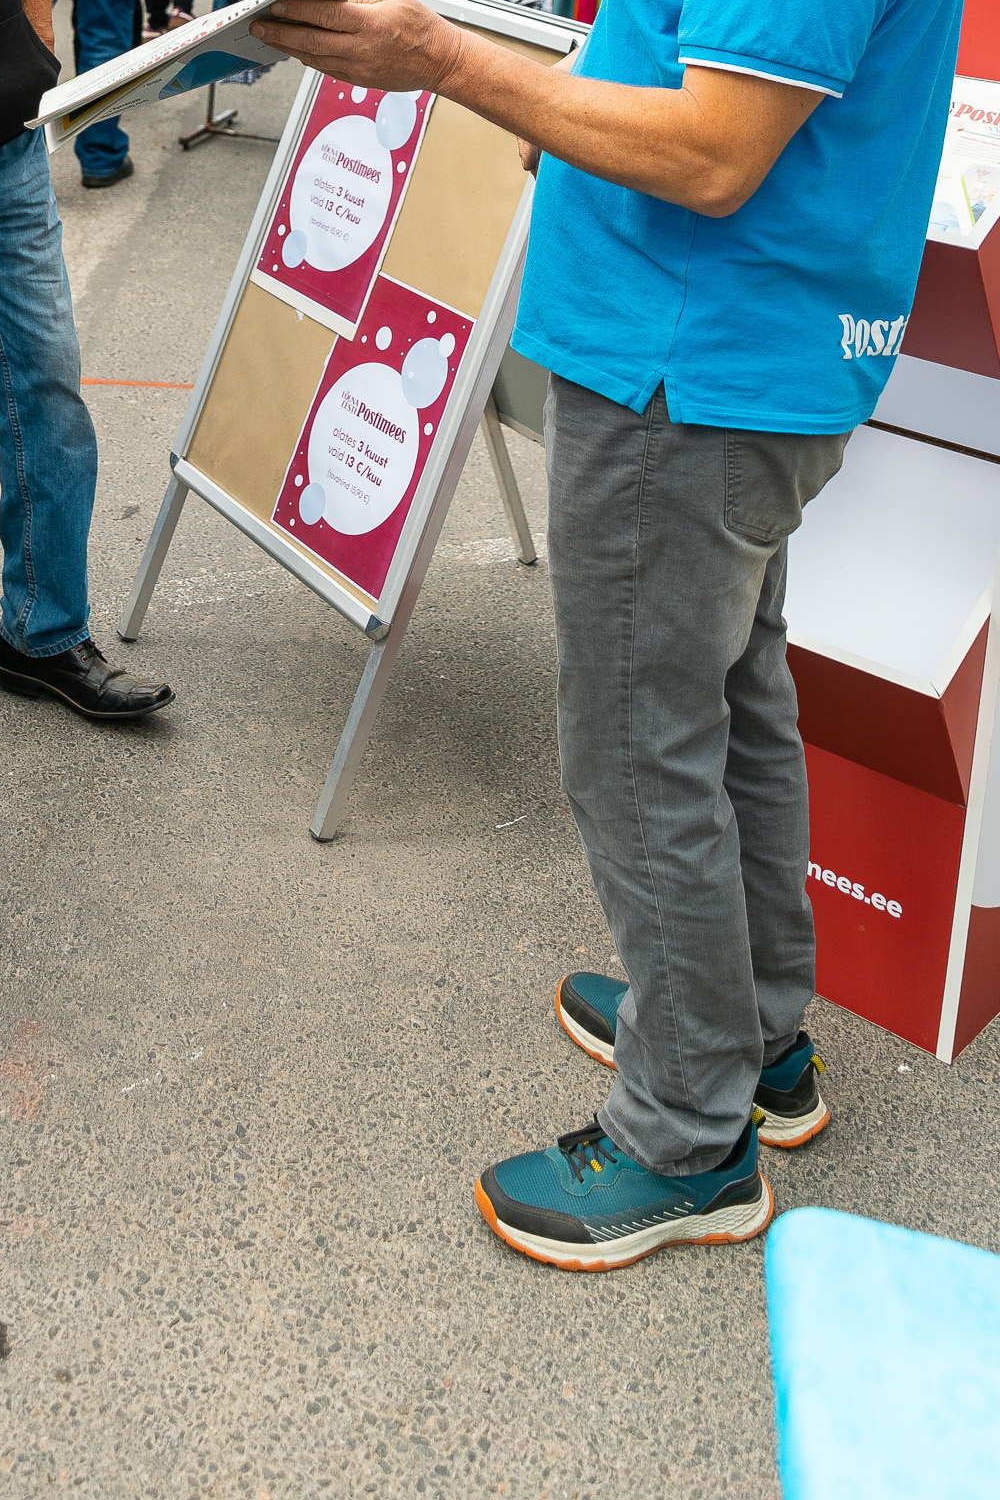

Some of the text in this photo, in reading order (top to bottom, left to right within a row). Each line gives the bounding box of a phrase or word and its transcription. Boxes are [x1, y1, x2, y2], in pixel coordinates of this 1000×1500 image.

[321, 152, 335, 164] EESTI
[335, 152, 381, 183] Postimees
[310, 194, 324, 207] vaid
[324, 199, 334, 211] 13
[314, 177, 365, 207] alates 3 kuust
[340, 390, 359, 406] LÕUNA
[340, 400, 357, 414] EESTI
[356, 401, 406, 443] Postimees
[328, 444, 345, 461] vaid
[344, 454, 355, 467] 13
[332, 427, 388, 468] alates 3 kuust
